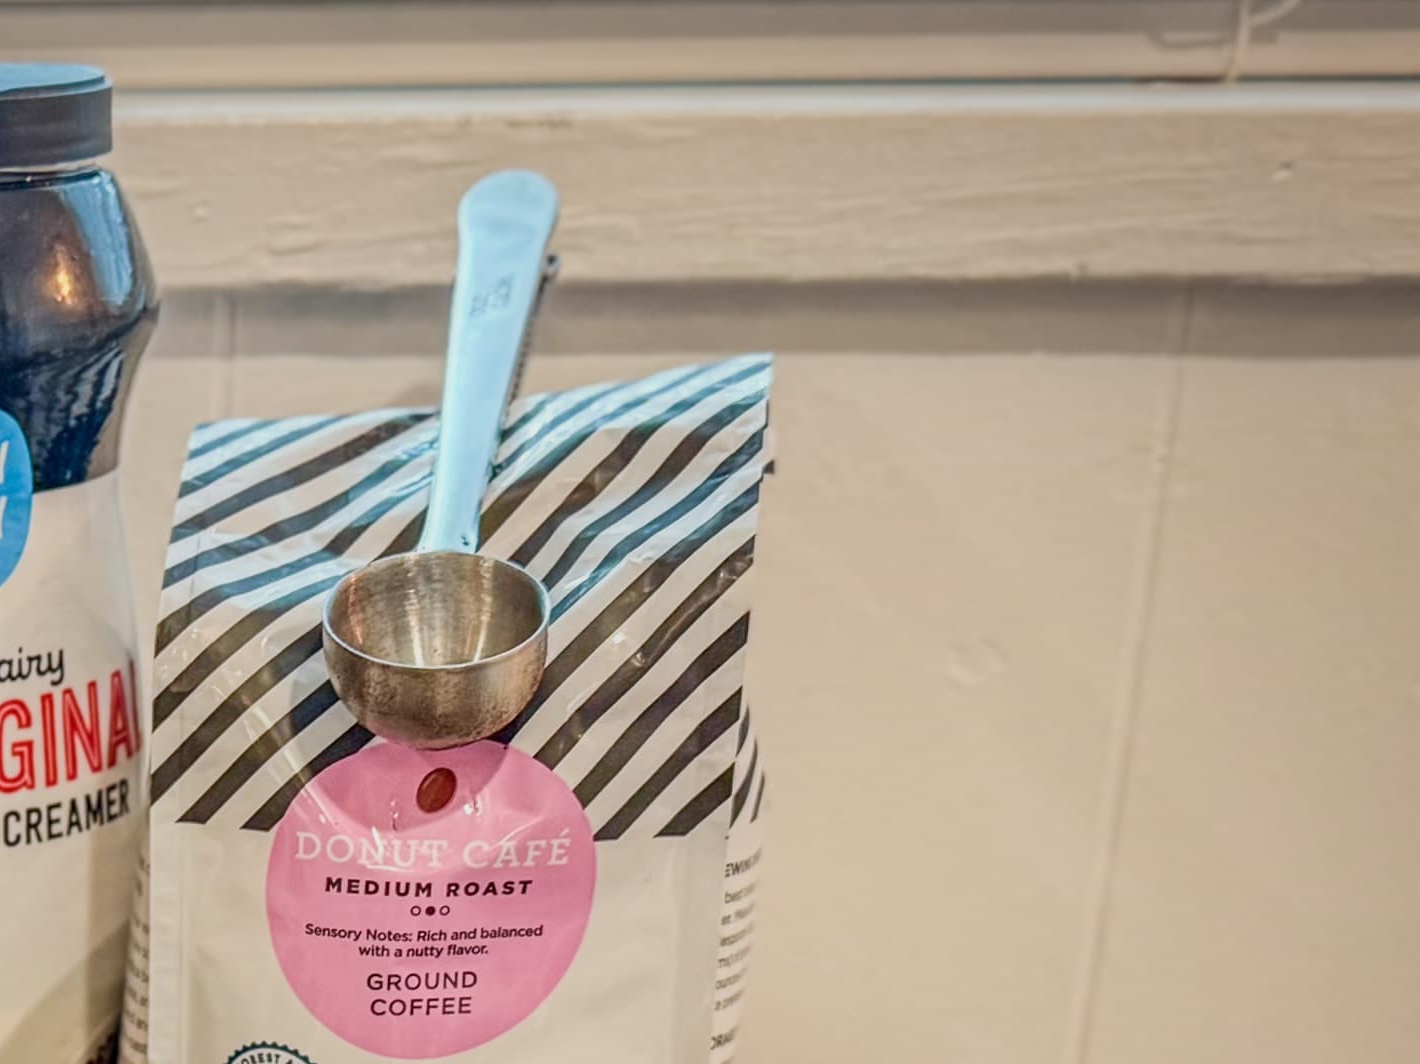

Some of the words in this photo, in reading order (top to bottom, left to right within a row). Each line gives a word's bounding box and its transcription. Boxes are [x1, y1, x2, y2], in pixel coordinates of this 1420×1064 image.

[2, 778, 130, 848] CREAMER
[294, 831, 449, 869] DONUT
[462, 828, 572, 868] CAFÉ
[324, 876, 432, 898] MEDIUM
[445, 879, 533, 898] ROAST
[304, 923, 362, 942] Sensory
[366, 928, 413, 943] Notes:
[416, 929, 448, 942] Rich
[450, 927, 477, 941] and
[480, 924, 544, 940] balanced
[358, 944, 391, 958] with
[394, 947, 403, 958] a
[406, 945, 443, 959] nutty
[446, 943, 489, 957] flavor.
[366, 970, 478, 992] GROUND
[369, 996, 473, 1017] COFFEE
